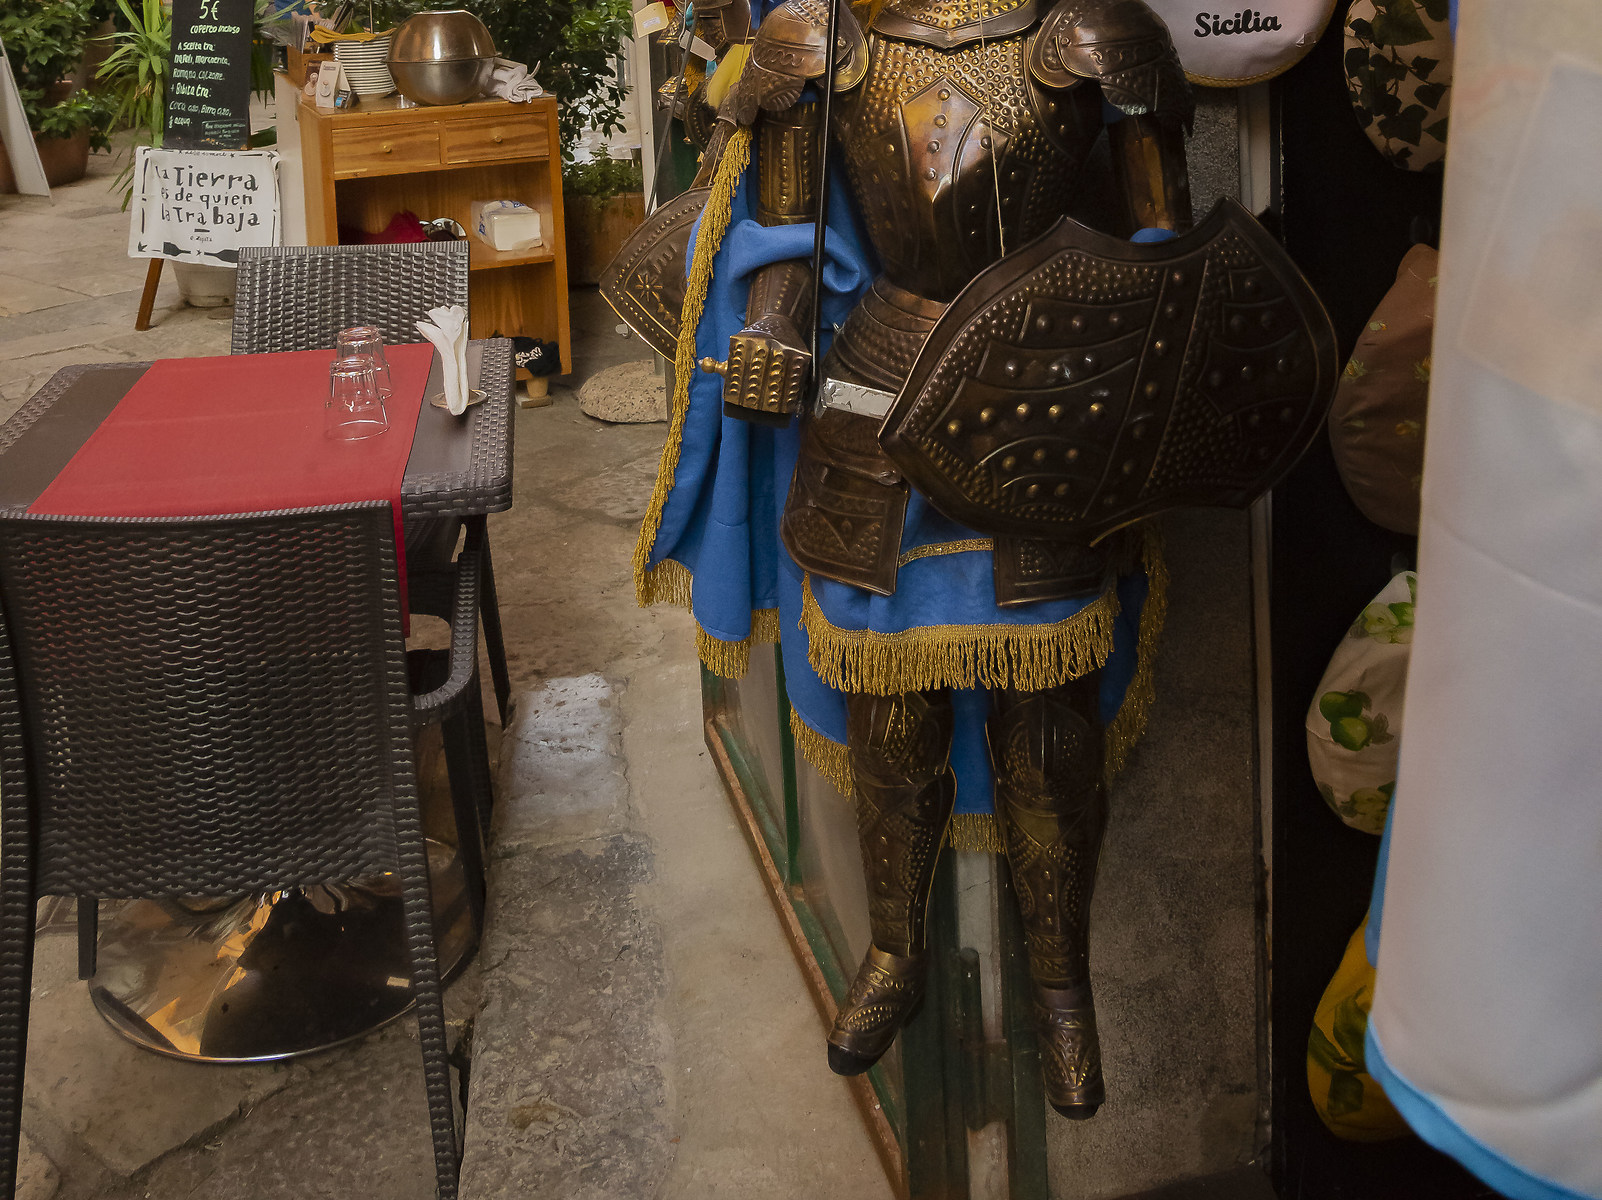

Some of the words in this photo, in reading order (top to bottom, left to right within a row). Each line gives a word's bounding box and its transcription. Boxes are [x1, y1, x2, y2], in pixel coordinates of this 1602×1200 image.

[1194, 9, 1282, 38] Sicilia
[173, 165, 259, 192] Tierra
[175, 187, 193, 202] de
[200, 192, 253, 210] quien
